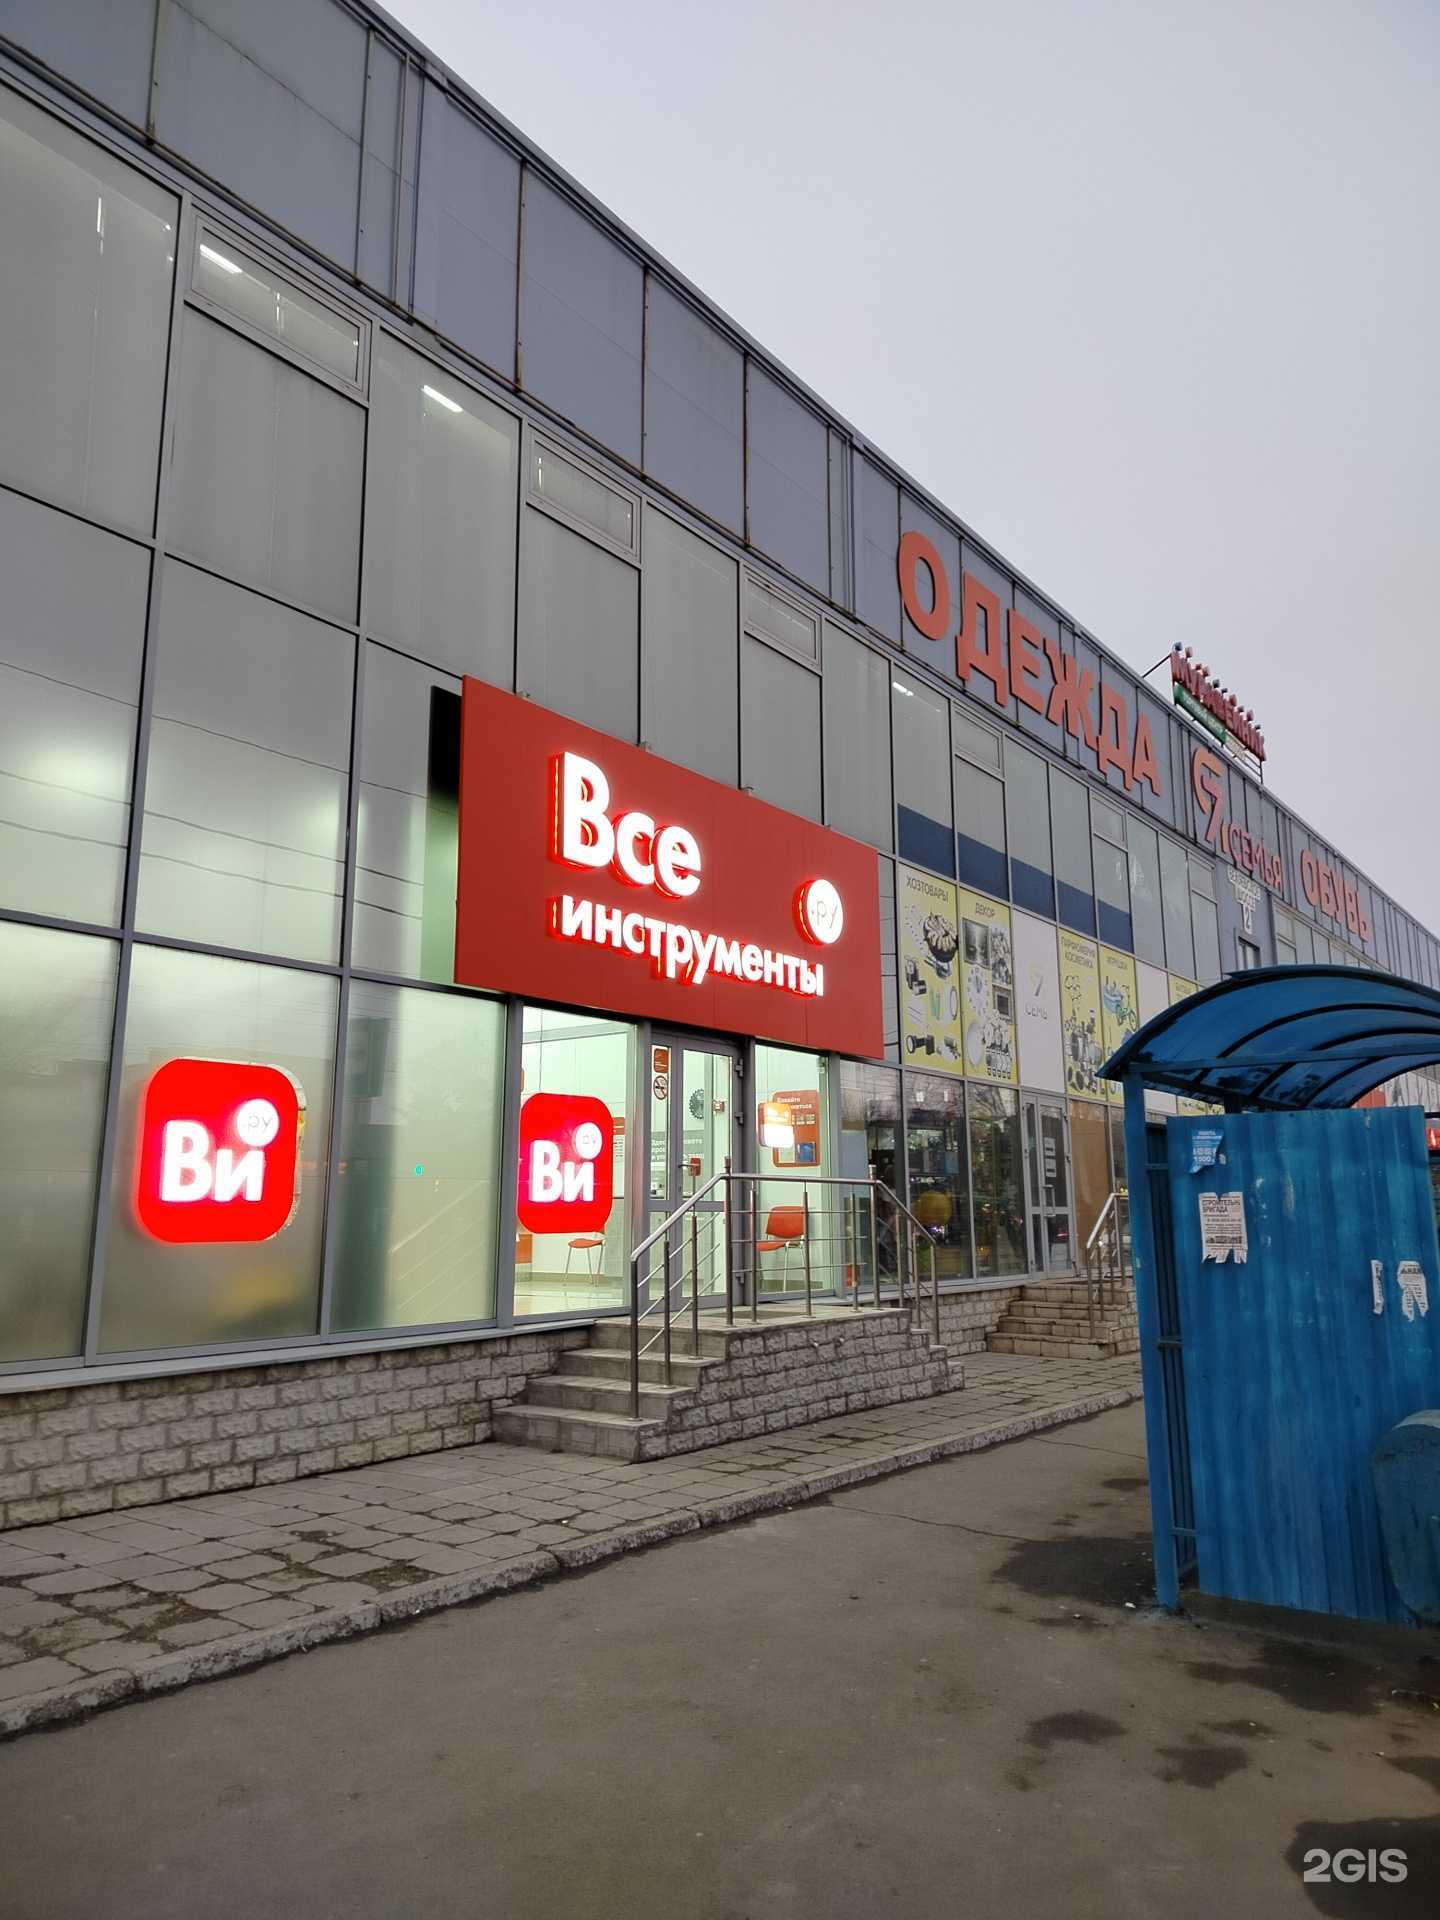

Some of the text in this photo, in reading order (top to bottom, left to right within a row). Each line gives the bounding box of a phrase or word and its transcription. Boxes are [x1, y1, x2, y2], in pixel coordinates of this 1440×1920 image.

[898, 531, 1161, 797] ОДЕЖДА
[557, 751, 702, 898] Все
[906, 875, 949, 903] ХОЗТОВАРЫ
[975, 902, 996, 919] ДЕКОР
[1301, 849, 1371, 943] ОБУВЬ
[556, 894, 825, 998] инструменты
